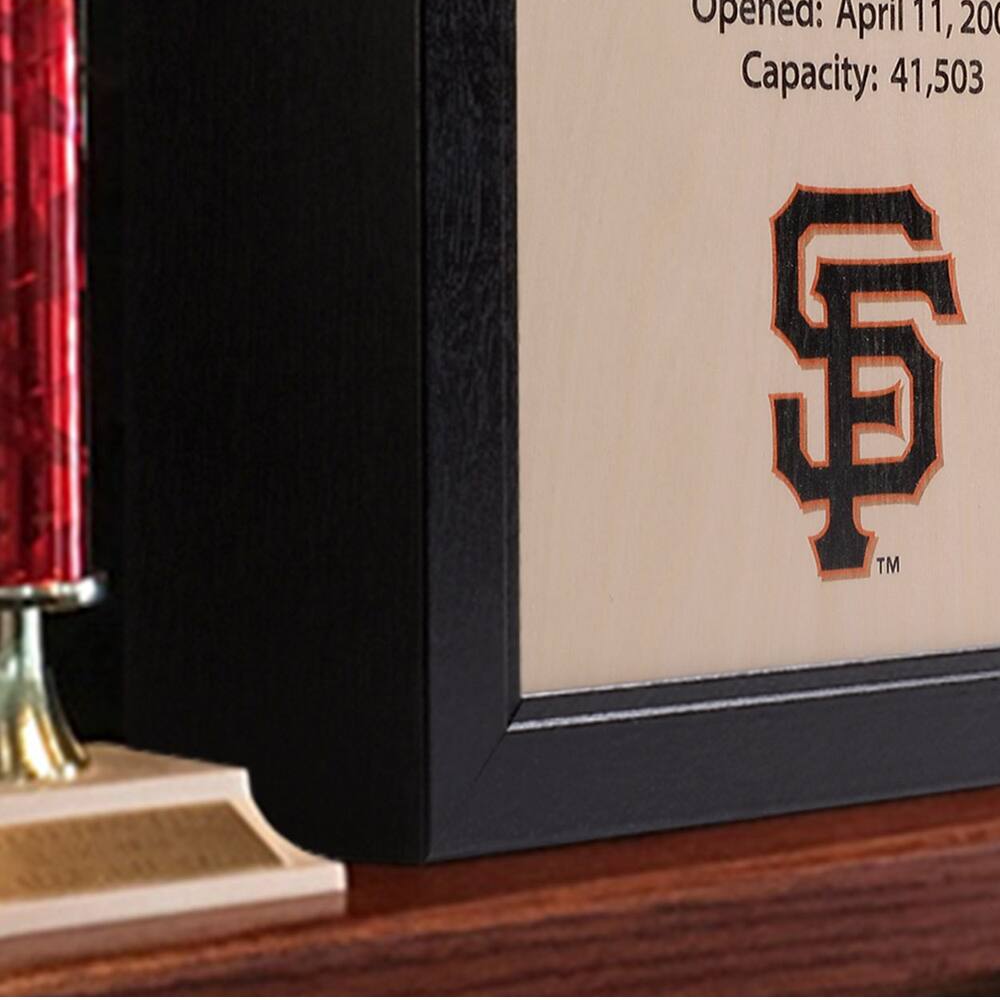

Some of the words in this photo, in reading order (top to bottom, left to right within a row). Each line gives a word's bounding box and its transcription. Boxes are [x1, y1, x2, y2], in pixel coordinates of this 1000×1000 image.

[741, 50, 878, 101] Capacity:
[890, 56, 984, 99] 41,503
[768, 182, 966, 582] SF
